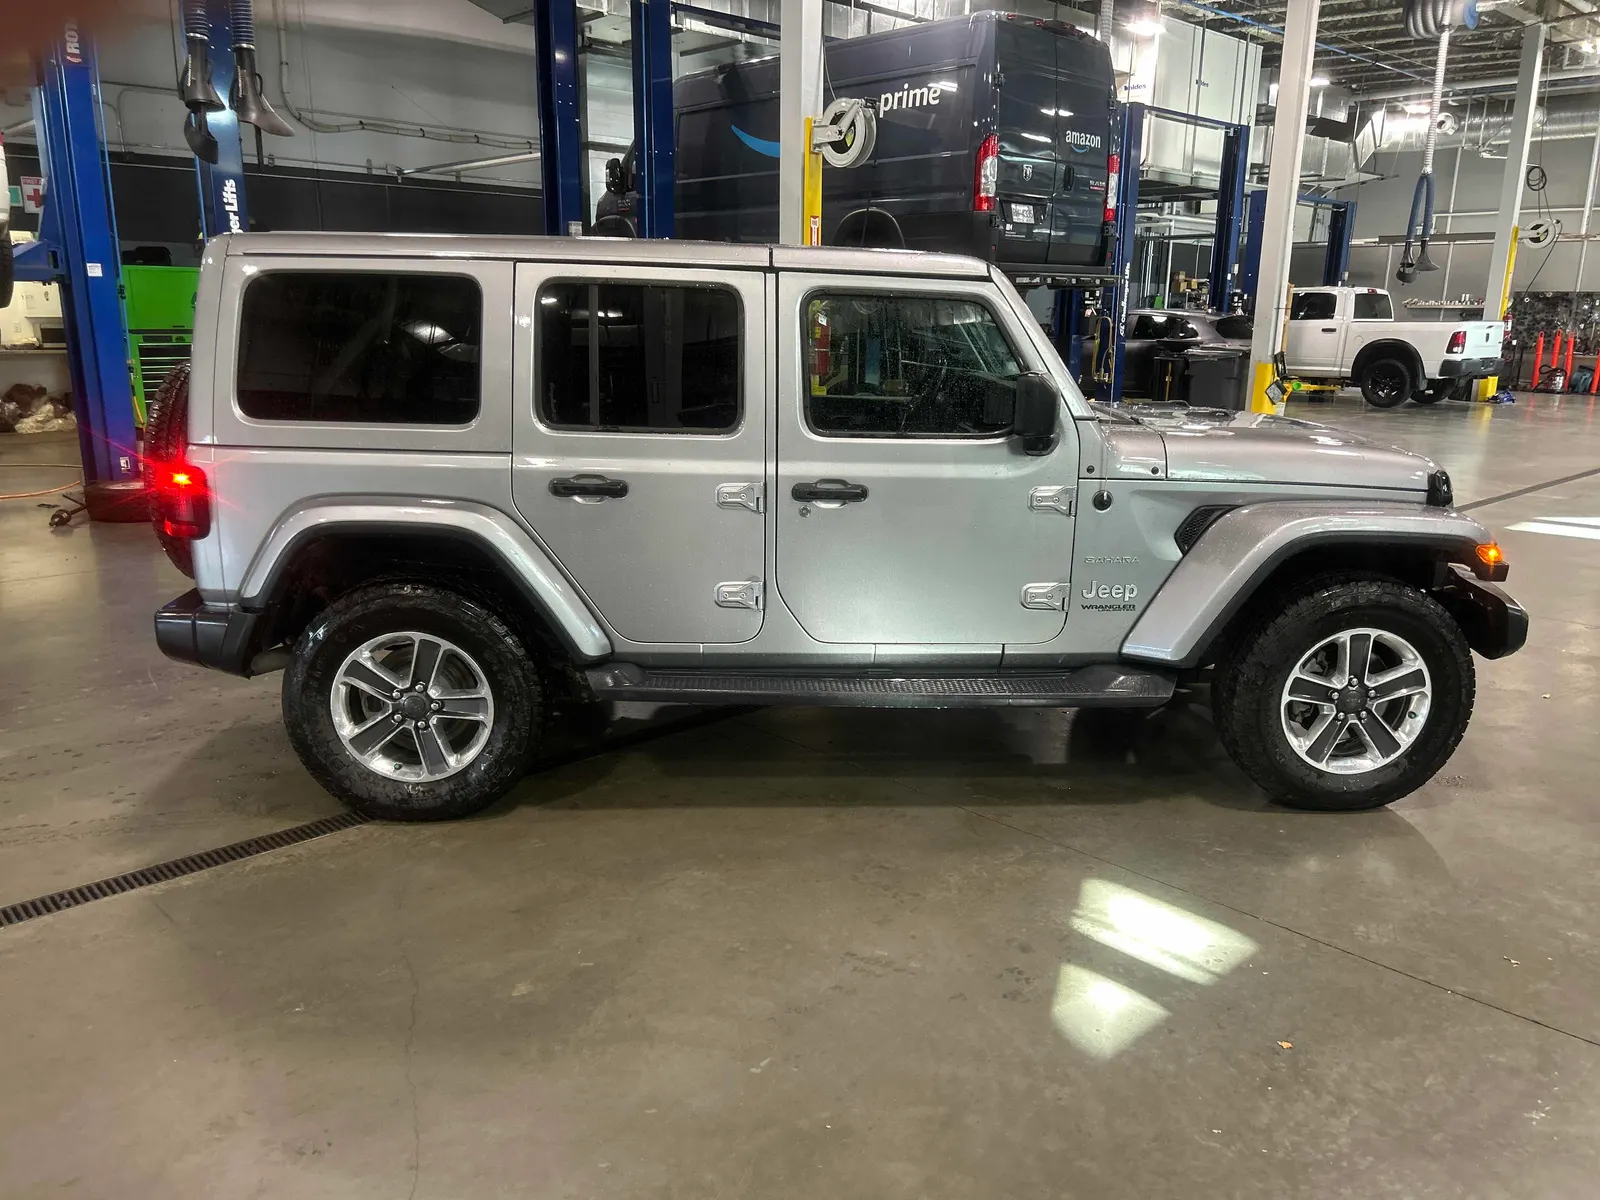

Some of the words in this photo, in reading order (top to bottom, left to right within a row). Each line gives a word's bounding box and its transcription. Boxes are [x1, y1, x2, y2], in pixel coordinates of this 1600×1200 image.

[879, 82, 941, 118] prime
[1065, 130, 1101, 149] amazon
[222, 179, 239, 212] Lifts
[1084, 556, 1140, 564] SAHARA
[1081, 580, 1138, 602] Jeep
